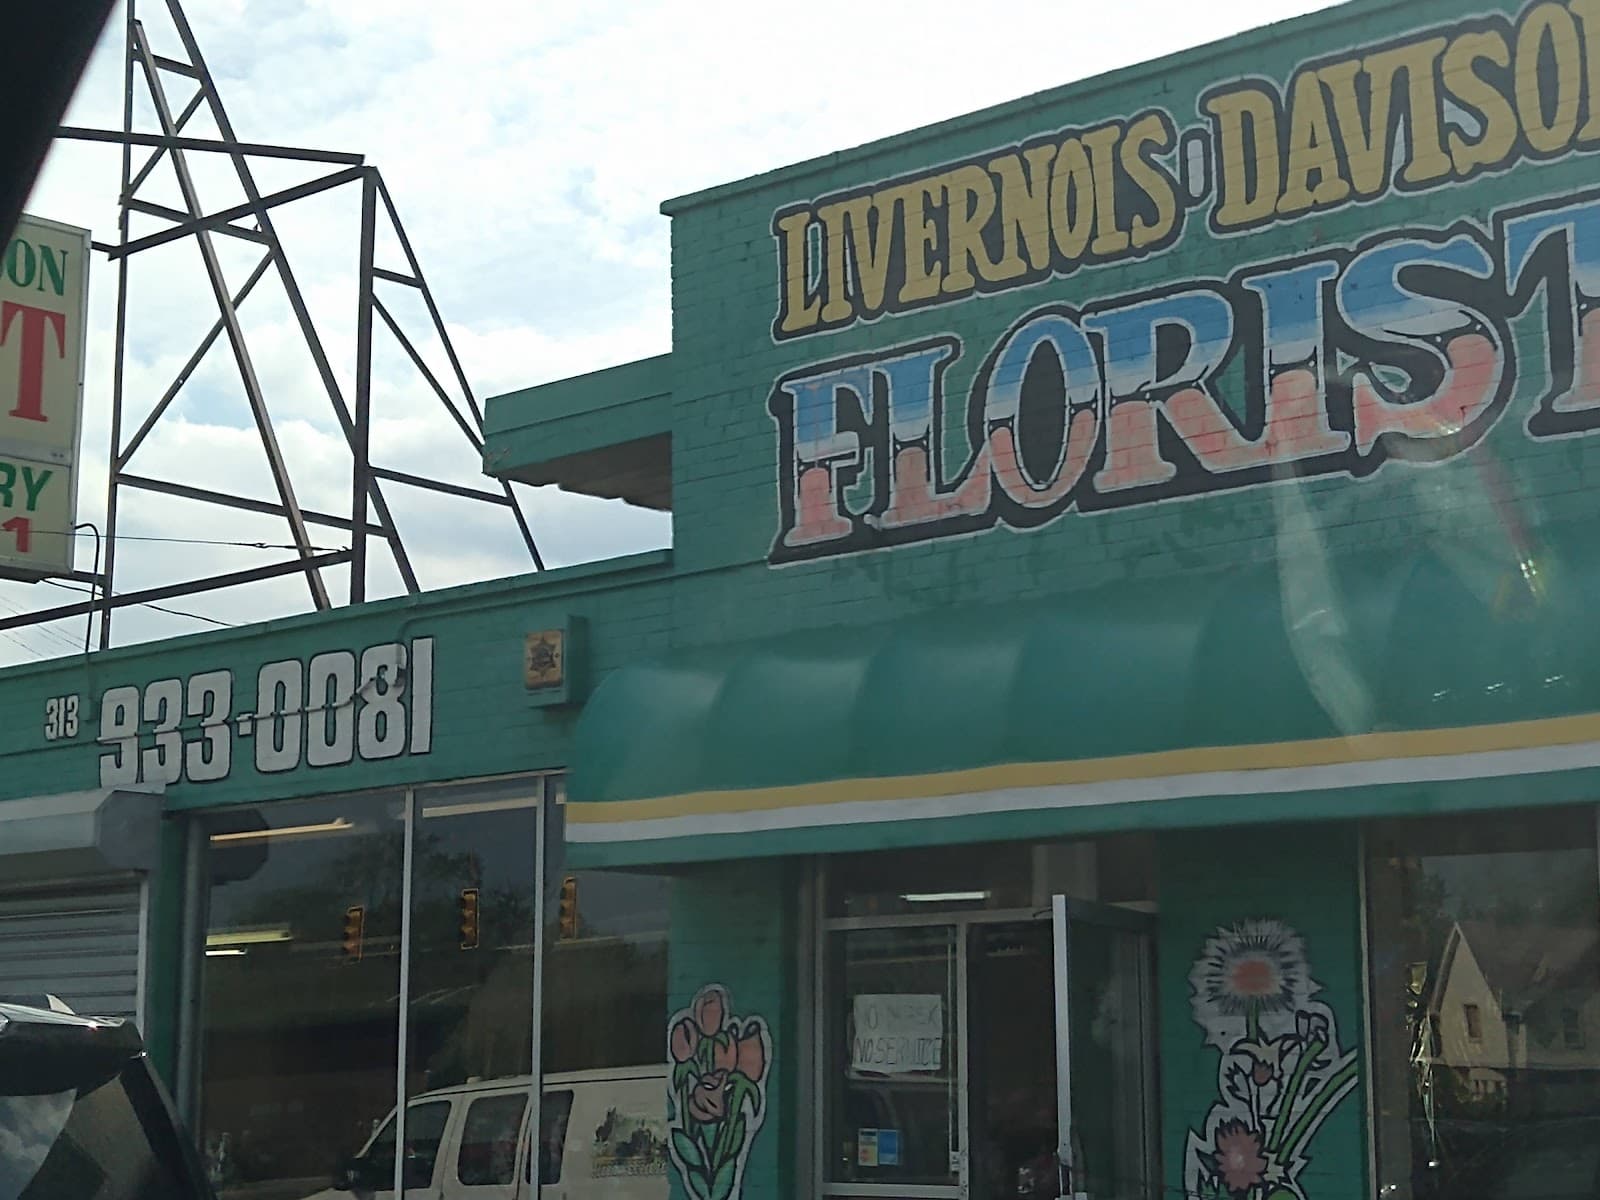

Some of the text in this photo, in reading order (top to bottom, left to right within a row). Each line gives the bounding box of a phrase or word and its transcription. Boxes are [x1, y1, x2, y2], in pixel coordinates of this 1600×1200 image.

[777, 0, 1600, 335] LIVERNOIS DAVISO
[0, 238, 69, 297] ON
[1, 301, 66, 422] T
[44, 636, 434, 787] 313 933-0081
[853, 1037, 874, 1063] NO
